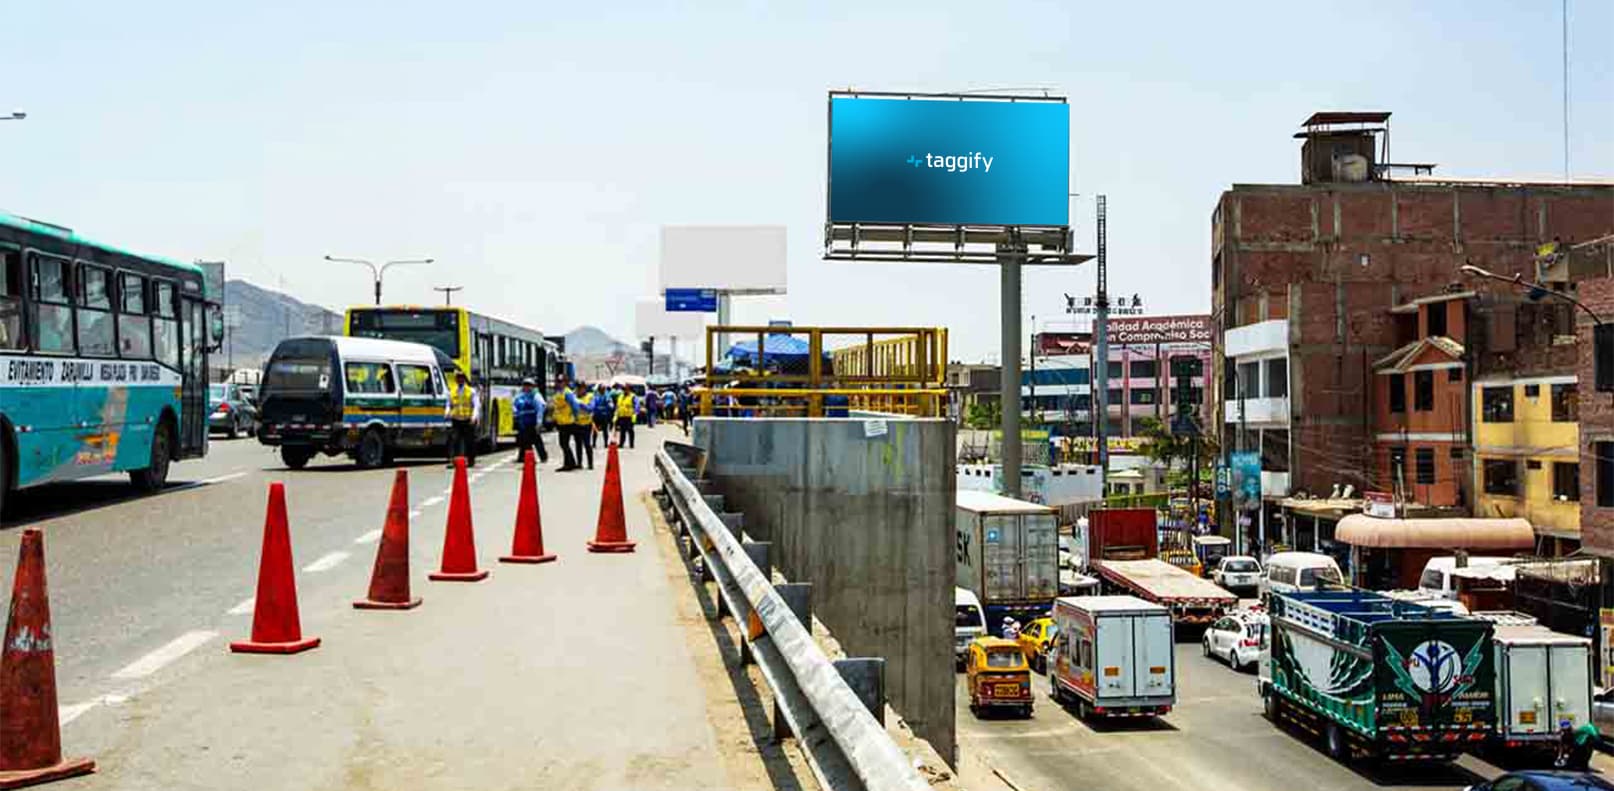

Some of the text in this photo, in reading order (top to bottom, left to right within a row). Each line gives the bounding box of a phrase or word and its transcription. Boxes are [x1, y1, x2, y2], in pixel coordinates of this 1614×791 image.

[925, 151, 994, 173] taggify
[1106, 318, 1204, 333] alidad Académica
[1118, 331, 1187, 342] Compromiso
[8, 360, 54, 381] EVITAMIENTO
